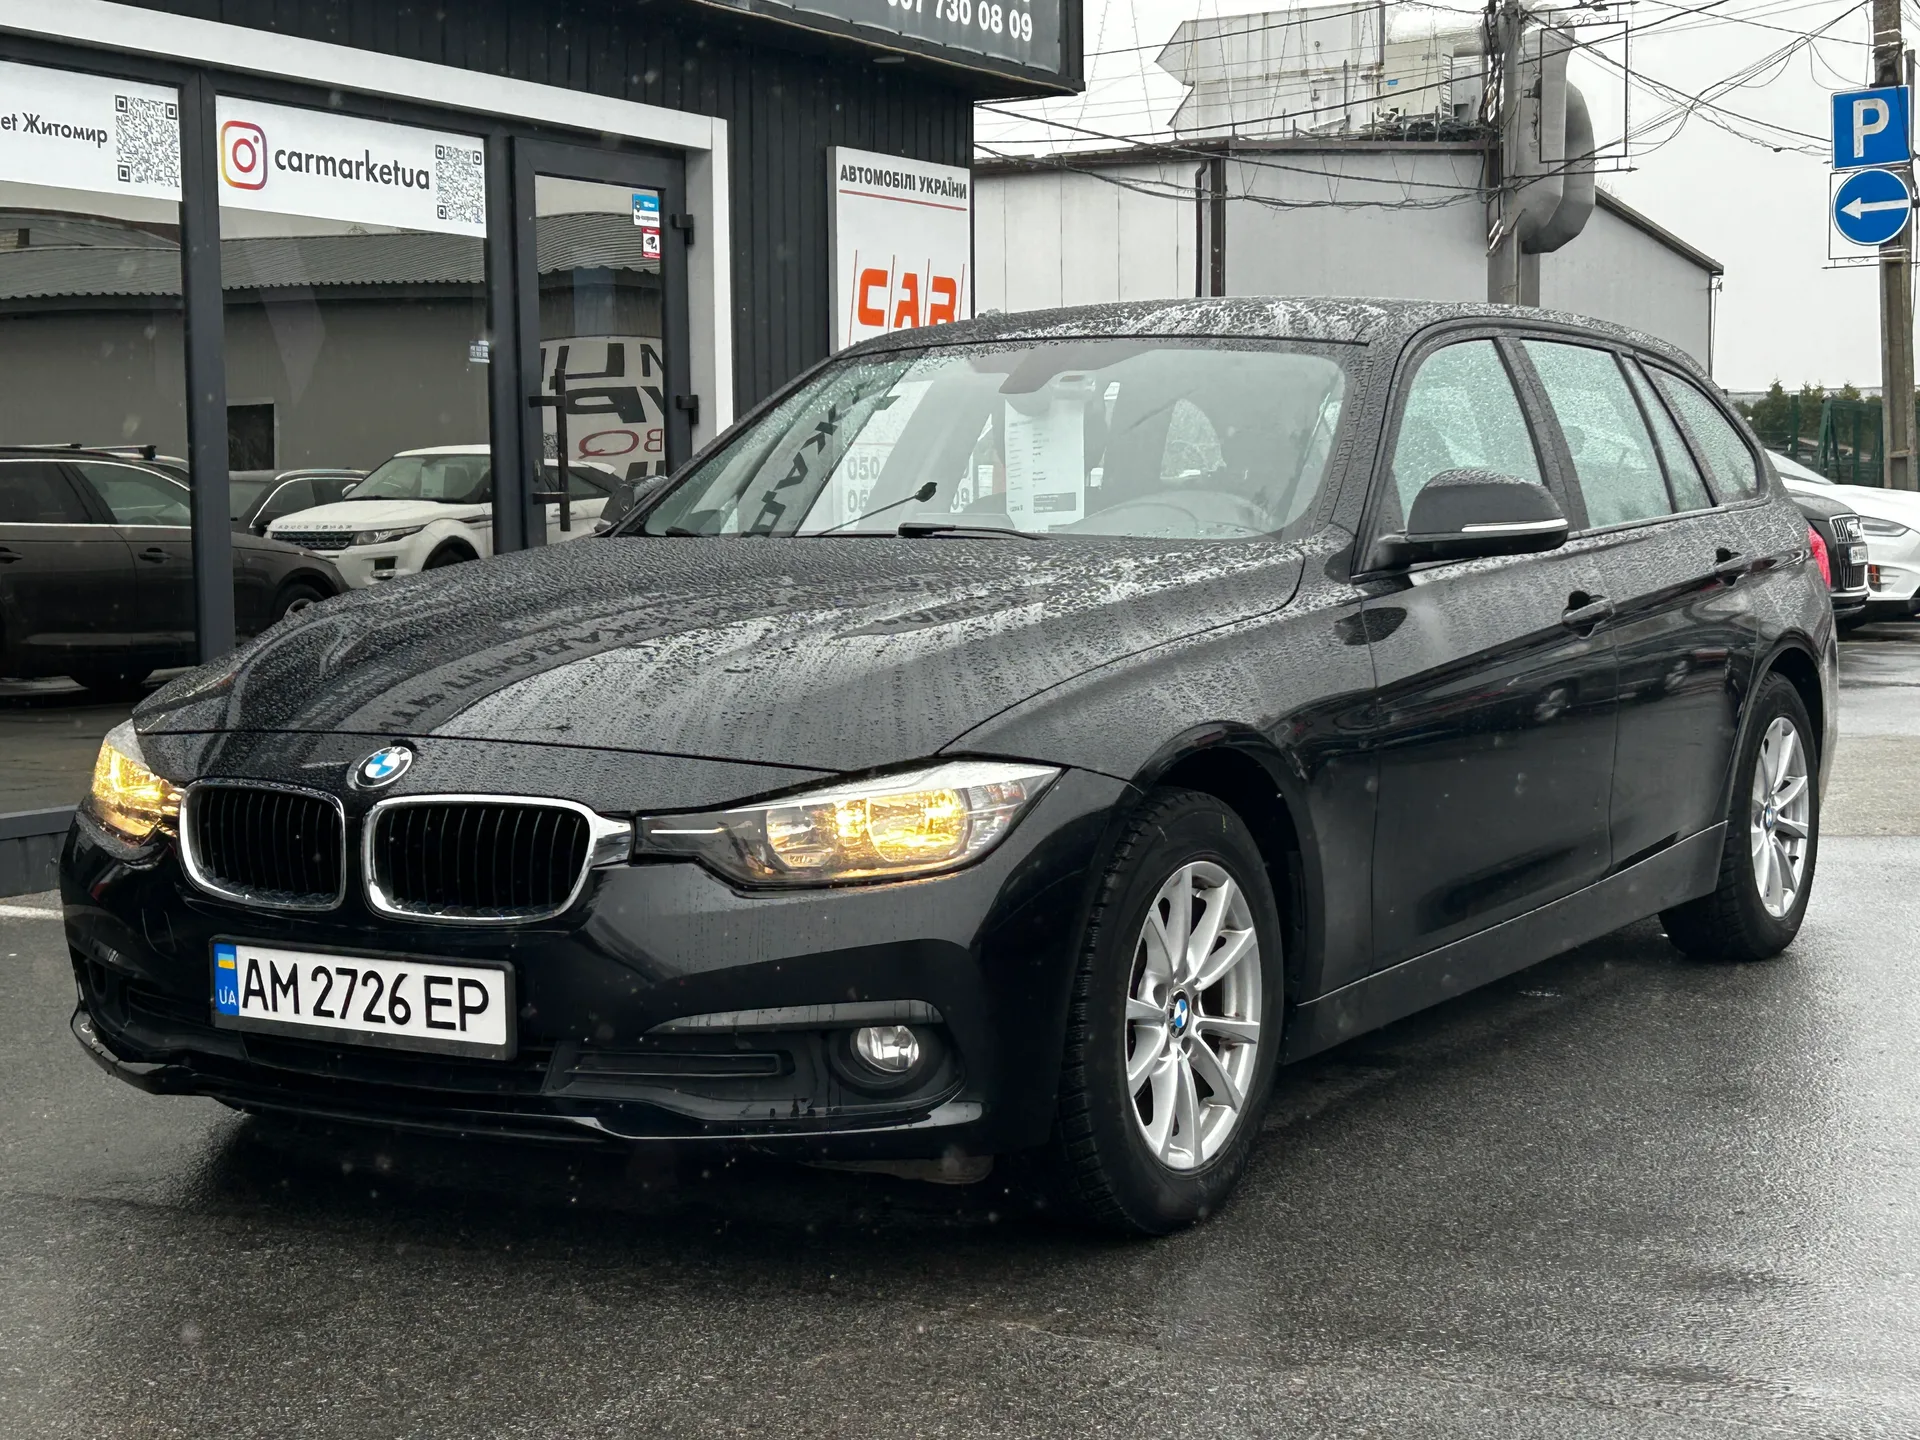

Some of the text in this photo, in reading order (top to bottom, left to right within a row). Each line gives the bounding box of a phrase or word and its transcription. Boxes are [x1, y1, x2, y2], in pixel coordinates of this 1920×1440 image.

[978, 0, 1003, 34] 08
[1009, 9, 1033, 42] 09
[22, 112, 108, 148] Житомир
[1853, 98, 1890, 158] P
[274, 149, 430, 190] carmarketua
[840, 164, 967, 199] АВТОМОБІЛІ УКРАЇНИ
[858, 268, 957, 328] CAR
[847, 456, 880, 480] 050
[219, 990, 237, 1006] UA
[241, 958, 489, 1032] AM 2726 EP
